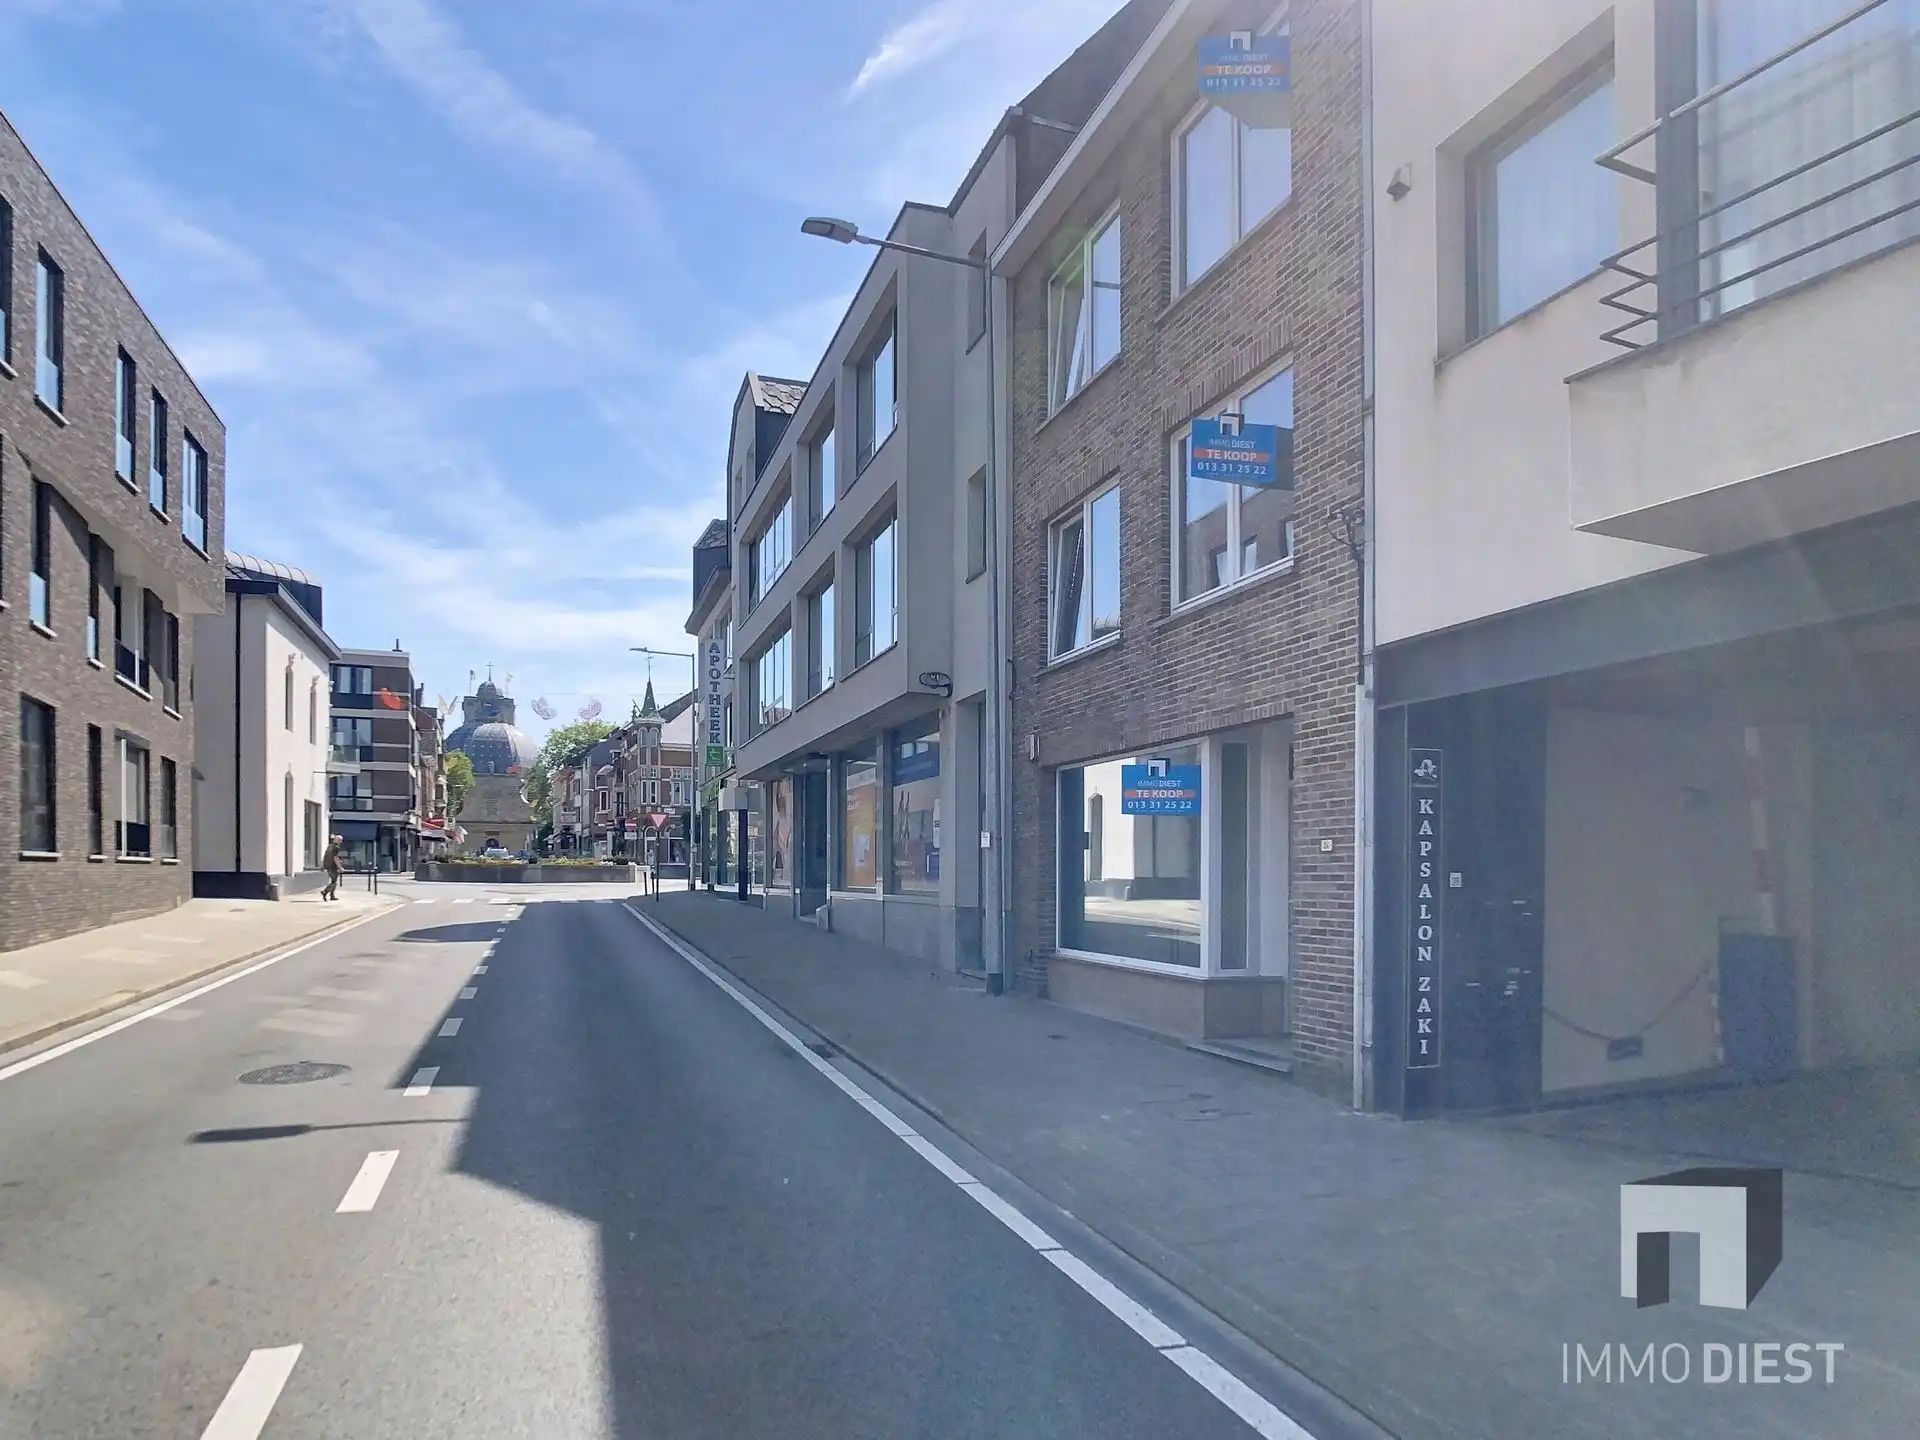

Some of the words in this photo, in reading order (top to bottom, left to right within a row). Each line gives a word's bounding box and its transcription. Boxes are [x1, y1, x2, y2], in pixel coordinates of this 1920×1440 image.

[1231, 440, 1256, 449] DIEST
[1205, 449, 1222, 460] TE
[1223, 451, 1257, 462] KOOP
[1197, 461, 1217, 472] 013
[1221, 463, 1233, 472] 31
[1237, 464, 1251, 474] 25
[1253, 465, 1267, 475] 22
[708, 641, 722, 744] APOTHEEK
[1159, 779, 1182, 788] DIEST
[1135, 789, 1150, 798] TE
[1152, 789, 1184, 798] KOOP
[1127, 801, 1146, 809] 013
[1149, 801, 1160, 809] 31
[1164, 801, 1177, 809] 25
[1179, 801, 1192, 809] 22
[1417, 799, 1434, 961] KAPSALON
[1416, 976, 1432, 1055] ZAKI
